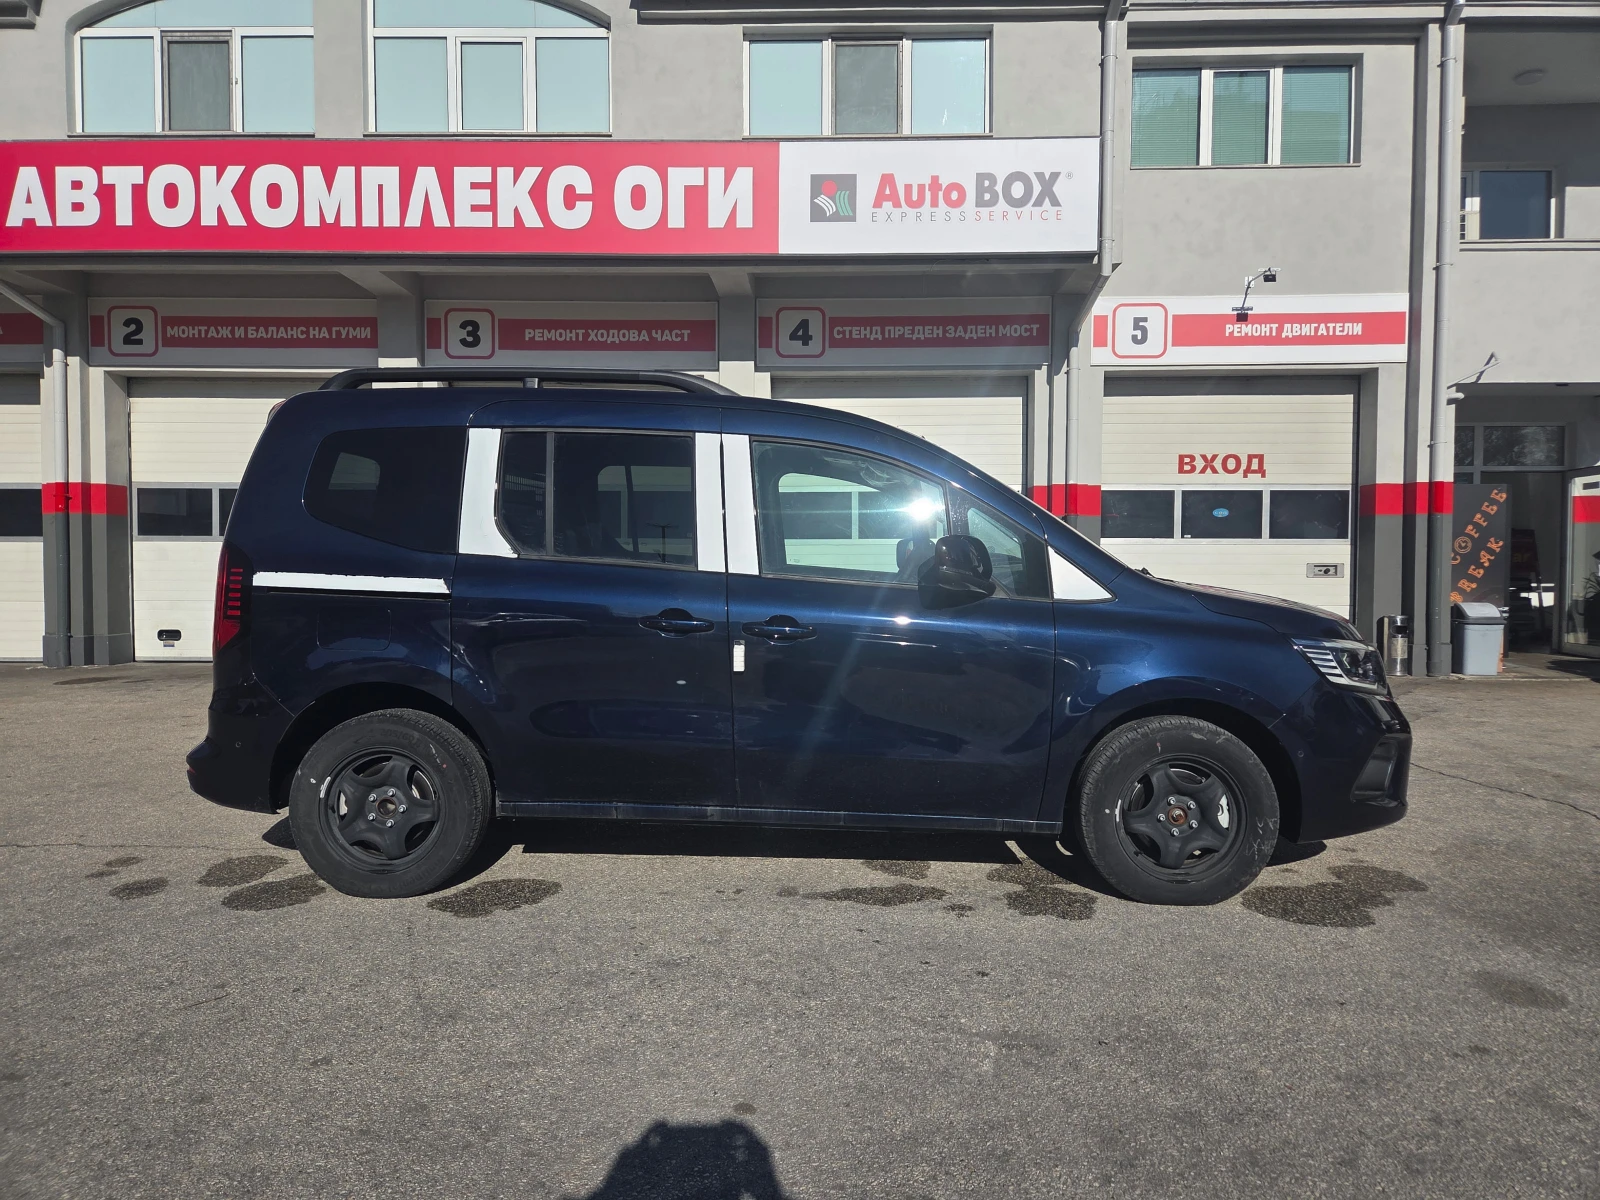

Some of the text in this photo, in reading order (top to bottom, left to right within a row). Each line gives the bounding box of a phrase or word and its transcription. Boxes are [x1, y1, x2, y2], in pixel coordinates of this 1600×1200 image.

[5, 164, 753, 230] АВТОКОМПЛЕКС ОГИ
[872, 172, 967, 209] Auto
[871, 210, 1063, 223] EXPRESS SERVICE
[122, 317, 145, 346] 2
[166, 325, 371, 340] МОНТАЖ И БАЛАНС НА ГУМИ
[458, 319, 482, 348] 3
[525, 328, 691, 344] РЕМОНТ ХОДОВА ЧАСТ
[788, 318, 813, 346] 4
[833, 324, 1040, 341] СТЕНД ПРЕДЕН ЗАДЕН МОСТ
[1131, 316, 1149, 346] 5
[1225, 322, 1362, 338] РЕМОНТ ДВИГАТЕЛИ
[1177, 453, 1267, 478] ВХОД
